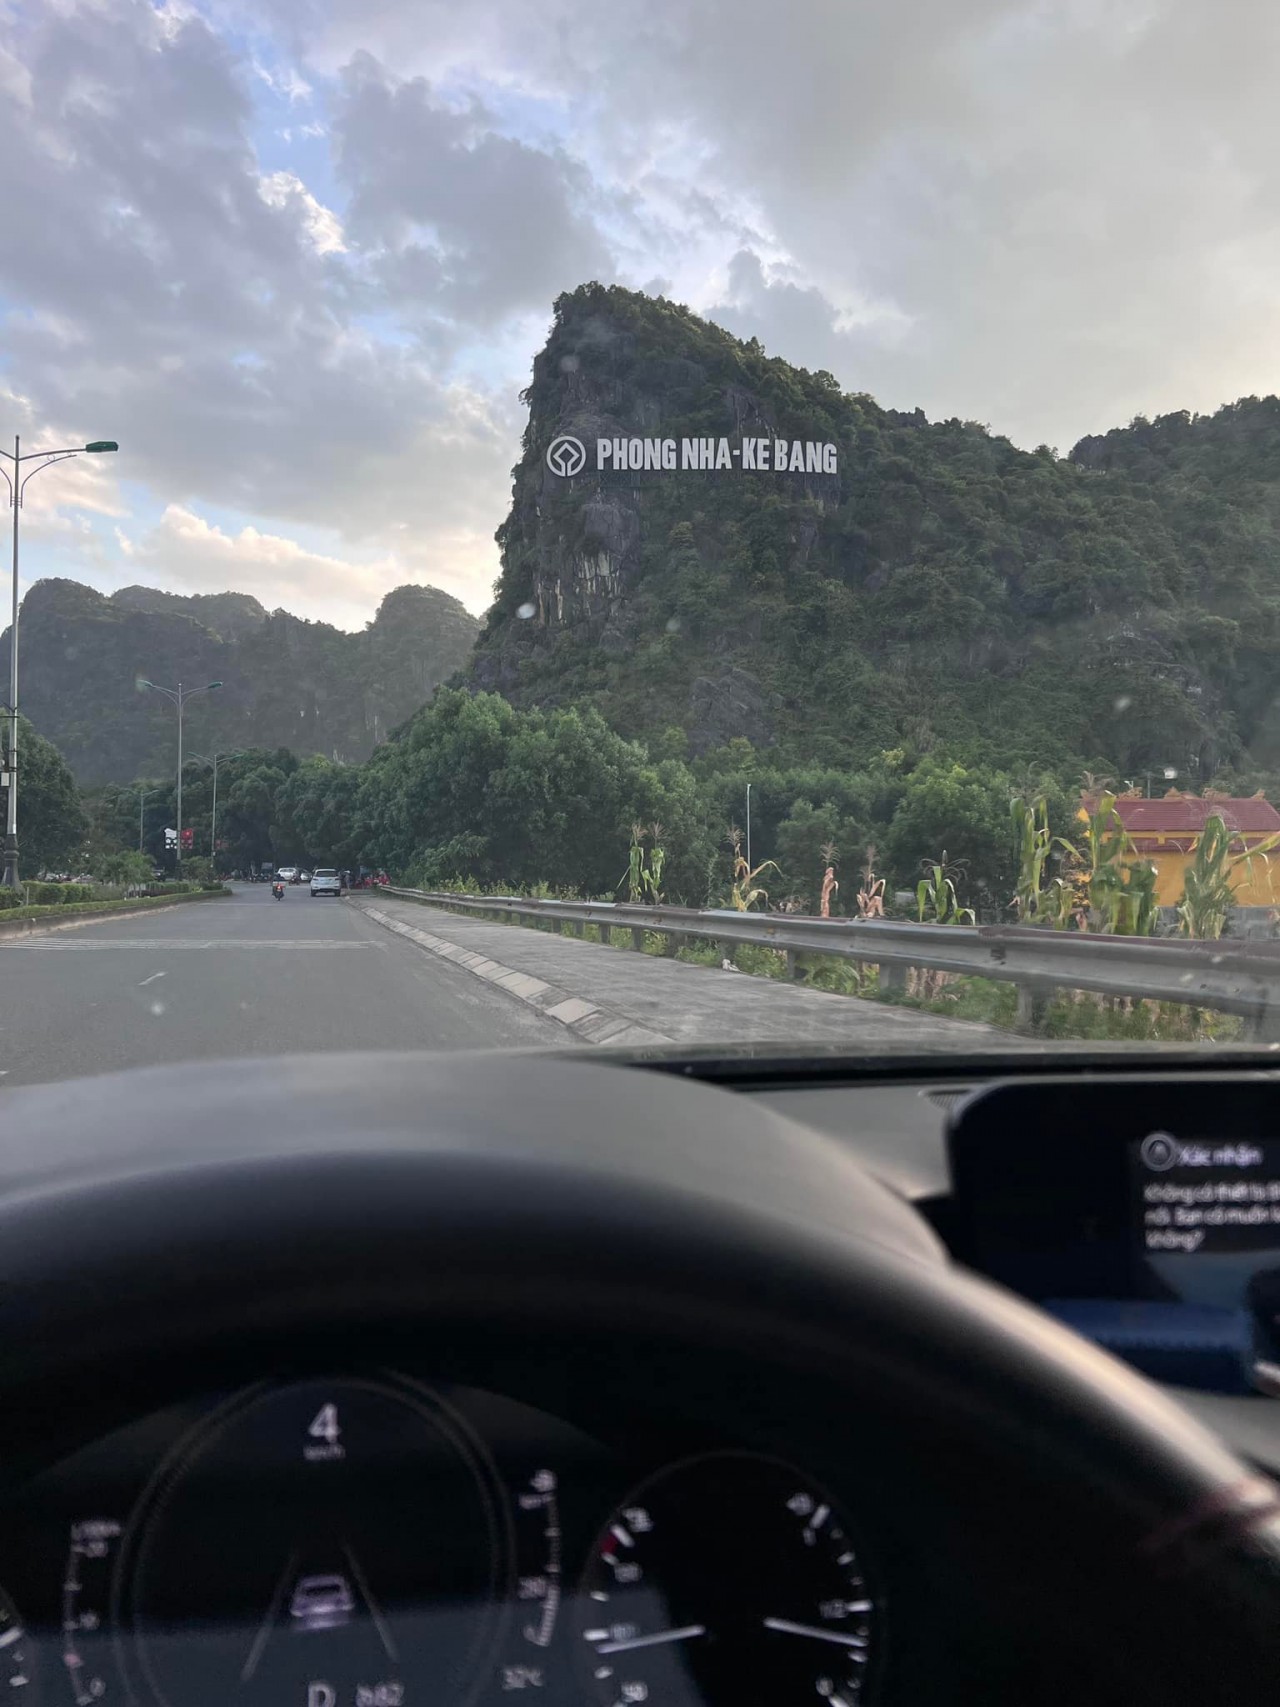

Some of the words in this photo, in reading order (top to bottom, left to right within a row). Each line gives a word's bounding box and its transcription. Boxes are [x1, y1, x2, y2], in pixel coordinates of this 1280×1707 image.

[597, 438, 677, 470] PHONG
[774, 439, 838, 474] BANG
[308, 1403, 341, 1442] 4
